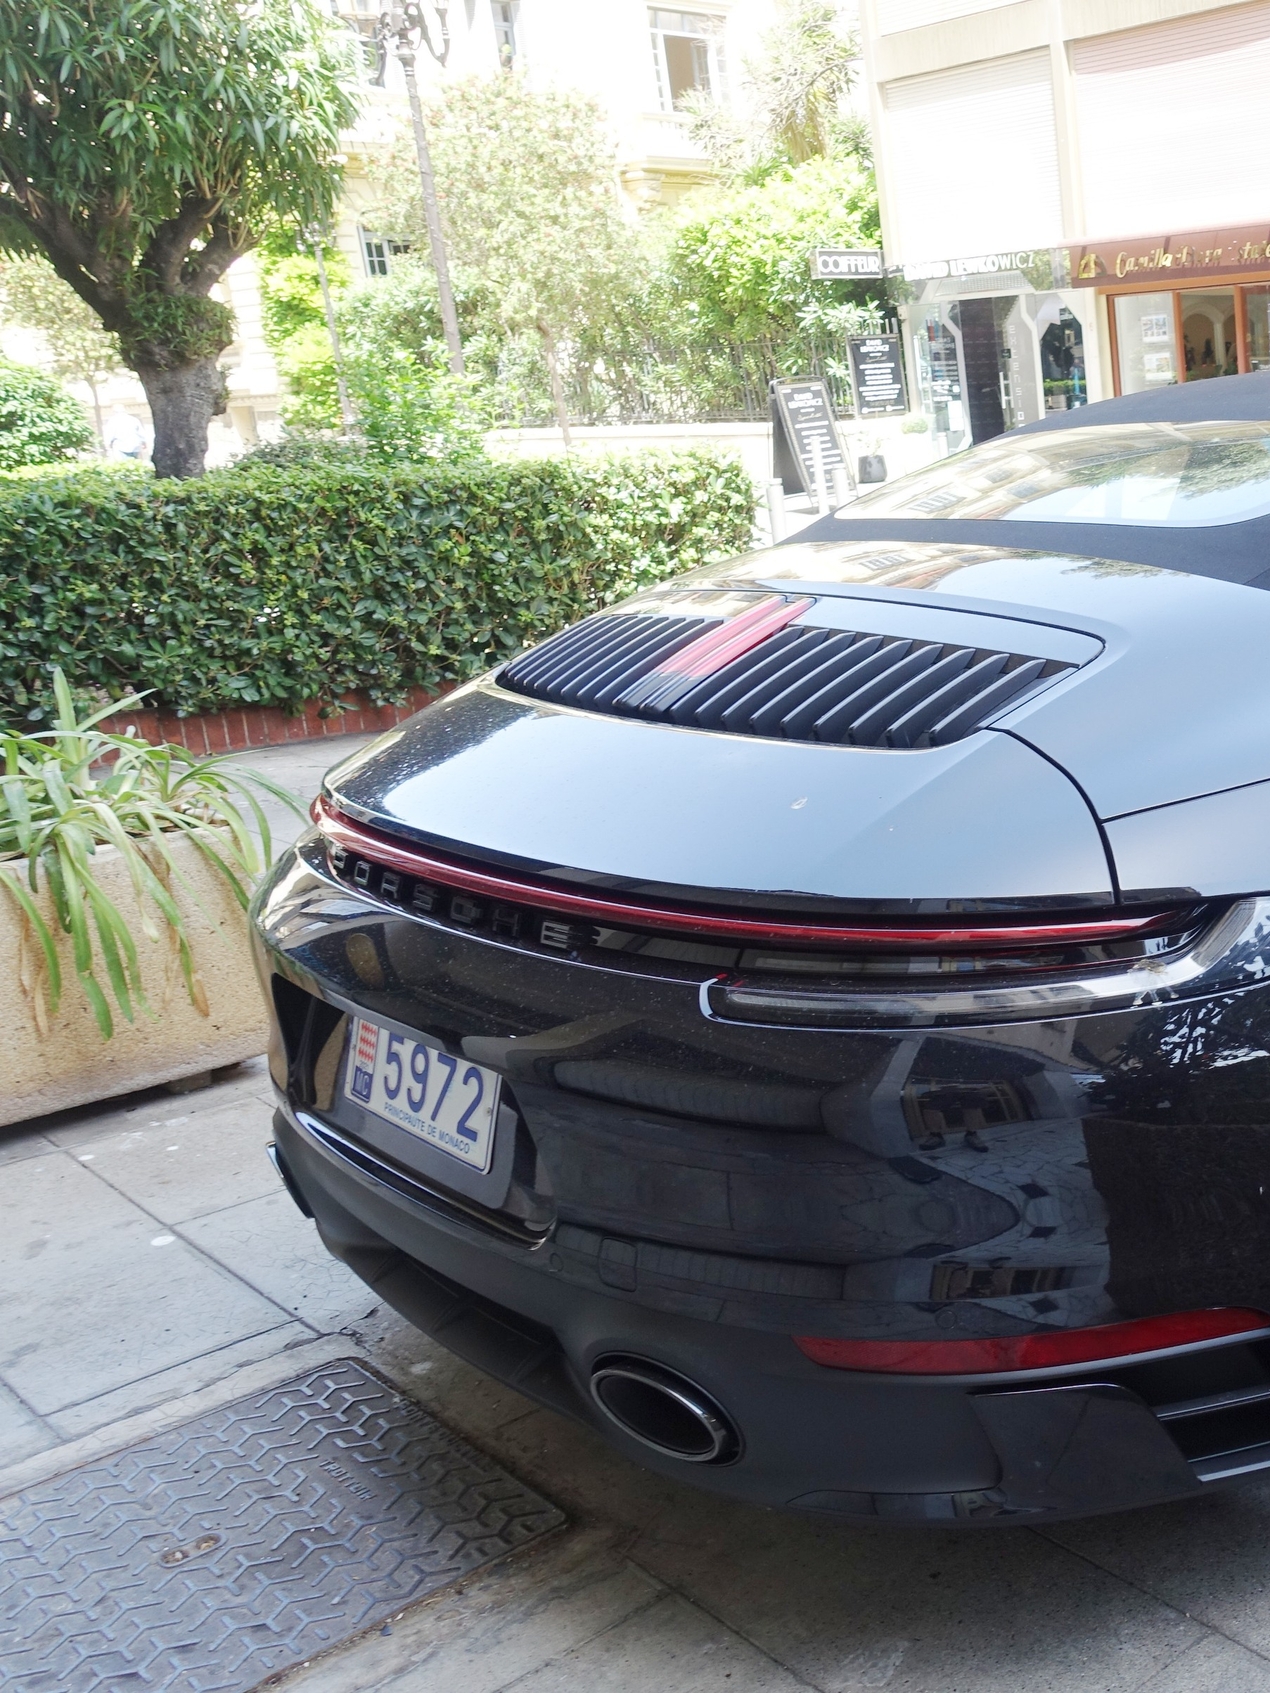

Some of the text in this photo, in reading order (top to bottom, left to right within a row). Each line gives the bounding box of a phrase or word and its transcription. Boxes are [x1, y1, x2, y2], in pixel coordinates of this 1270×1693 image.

[819, 255, 880, 274] COIFFEUR
[949, 251, 1036, 277] LEWKOWICZ
[333, 847, 574, 950] PORSCHE
[355, 1069, 370, 1096] MC
[383, 1031, 485, 1143] 5972
[384, 1101, 471, 1154] PRINCIPAUTE DE MONACO
